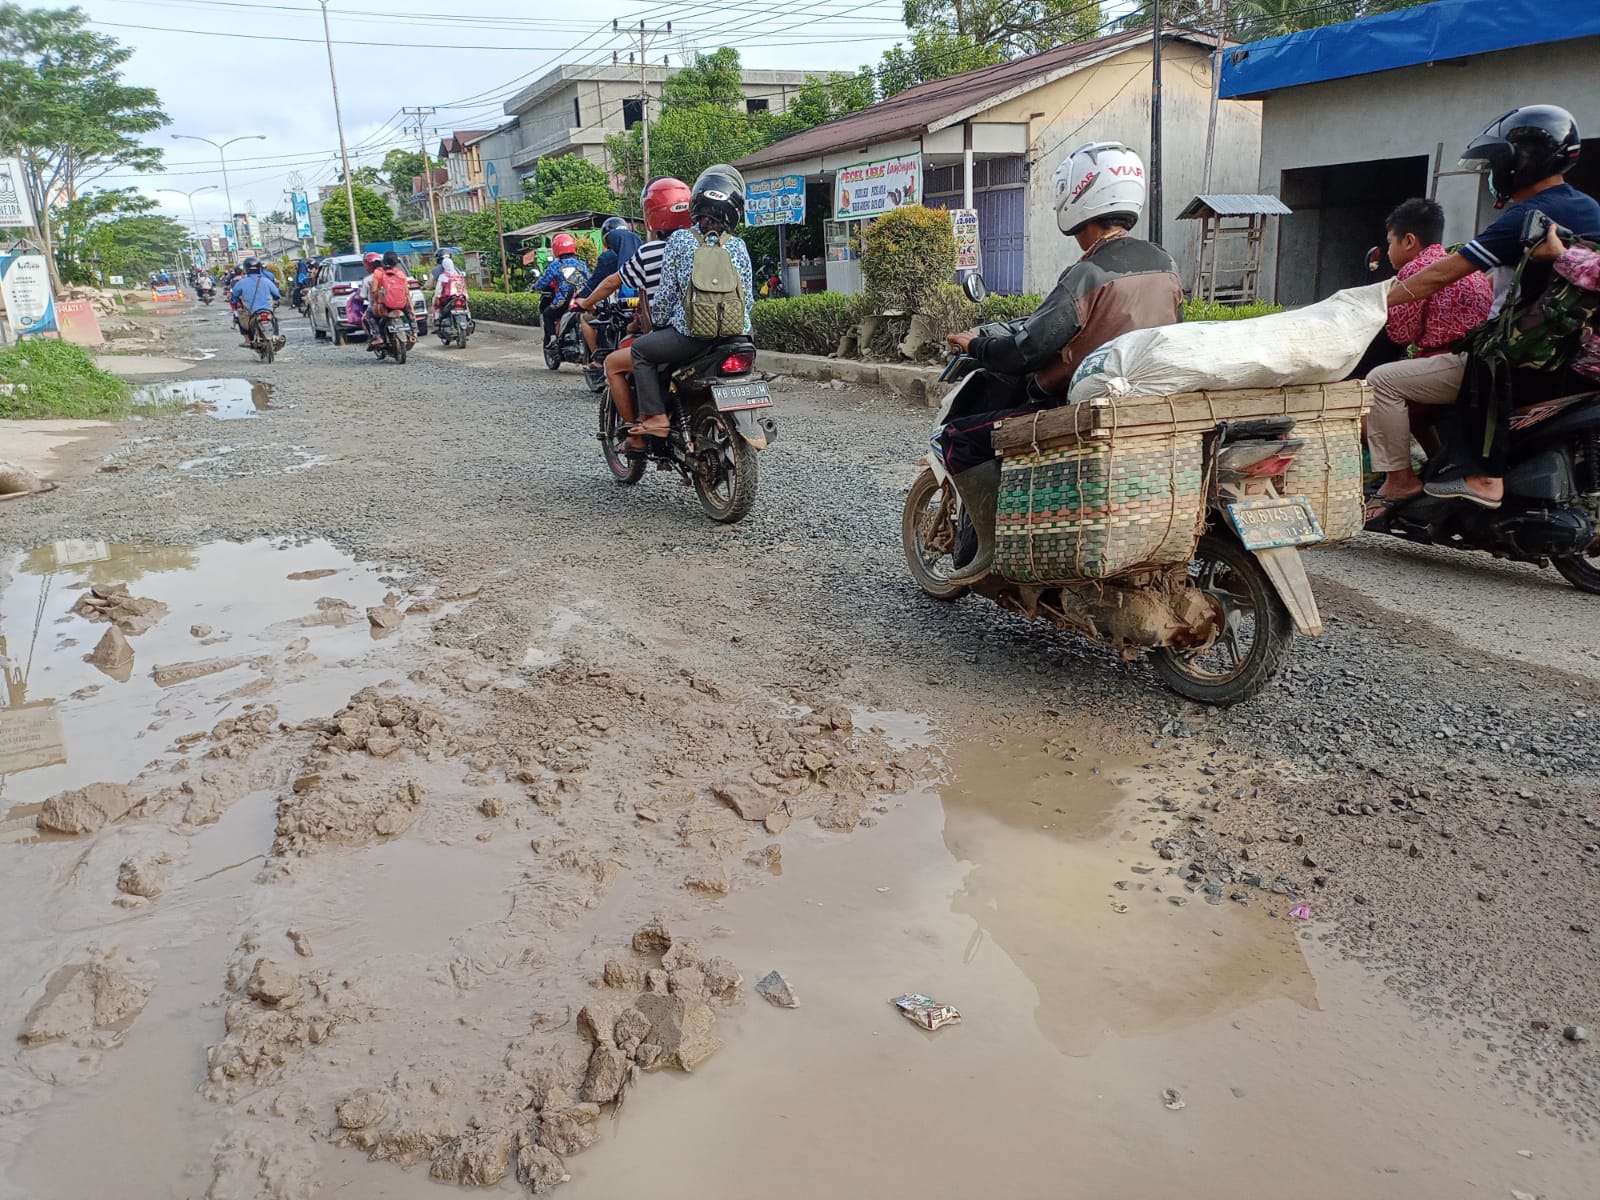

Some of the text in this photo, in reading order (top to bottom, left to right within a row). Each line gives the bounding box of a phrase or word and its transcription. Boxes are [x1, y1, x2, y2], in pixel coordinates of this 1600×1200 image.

[865, 165, 886, 181] LELE
[1108, 165, 1144, 177] VIAR
[1071, 172, 1095, 195] VIAR
[716, 388, 729, 399] KB
